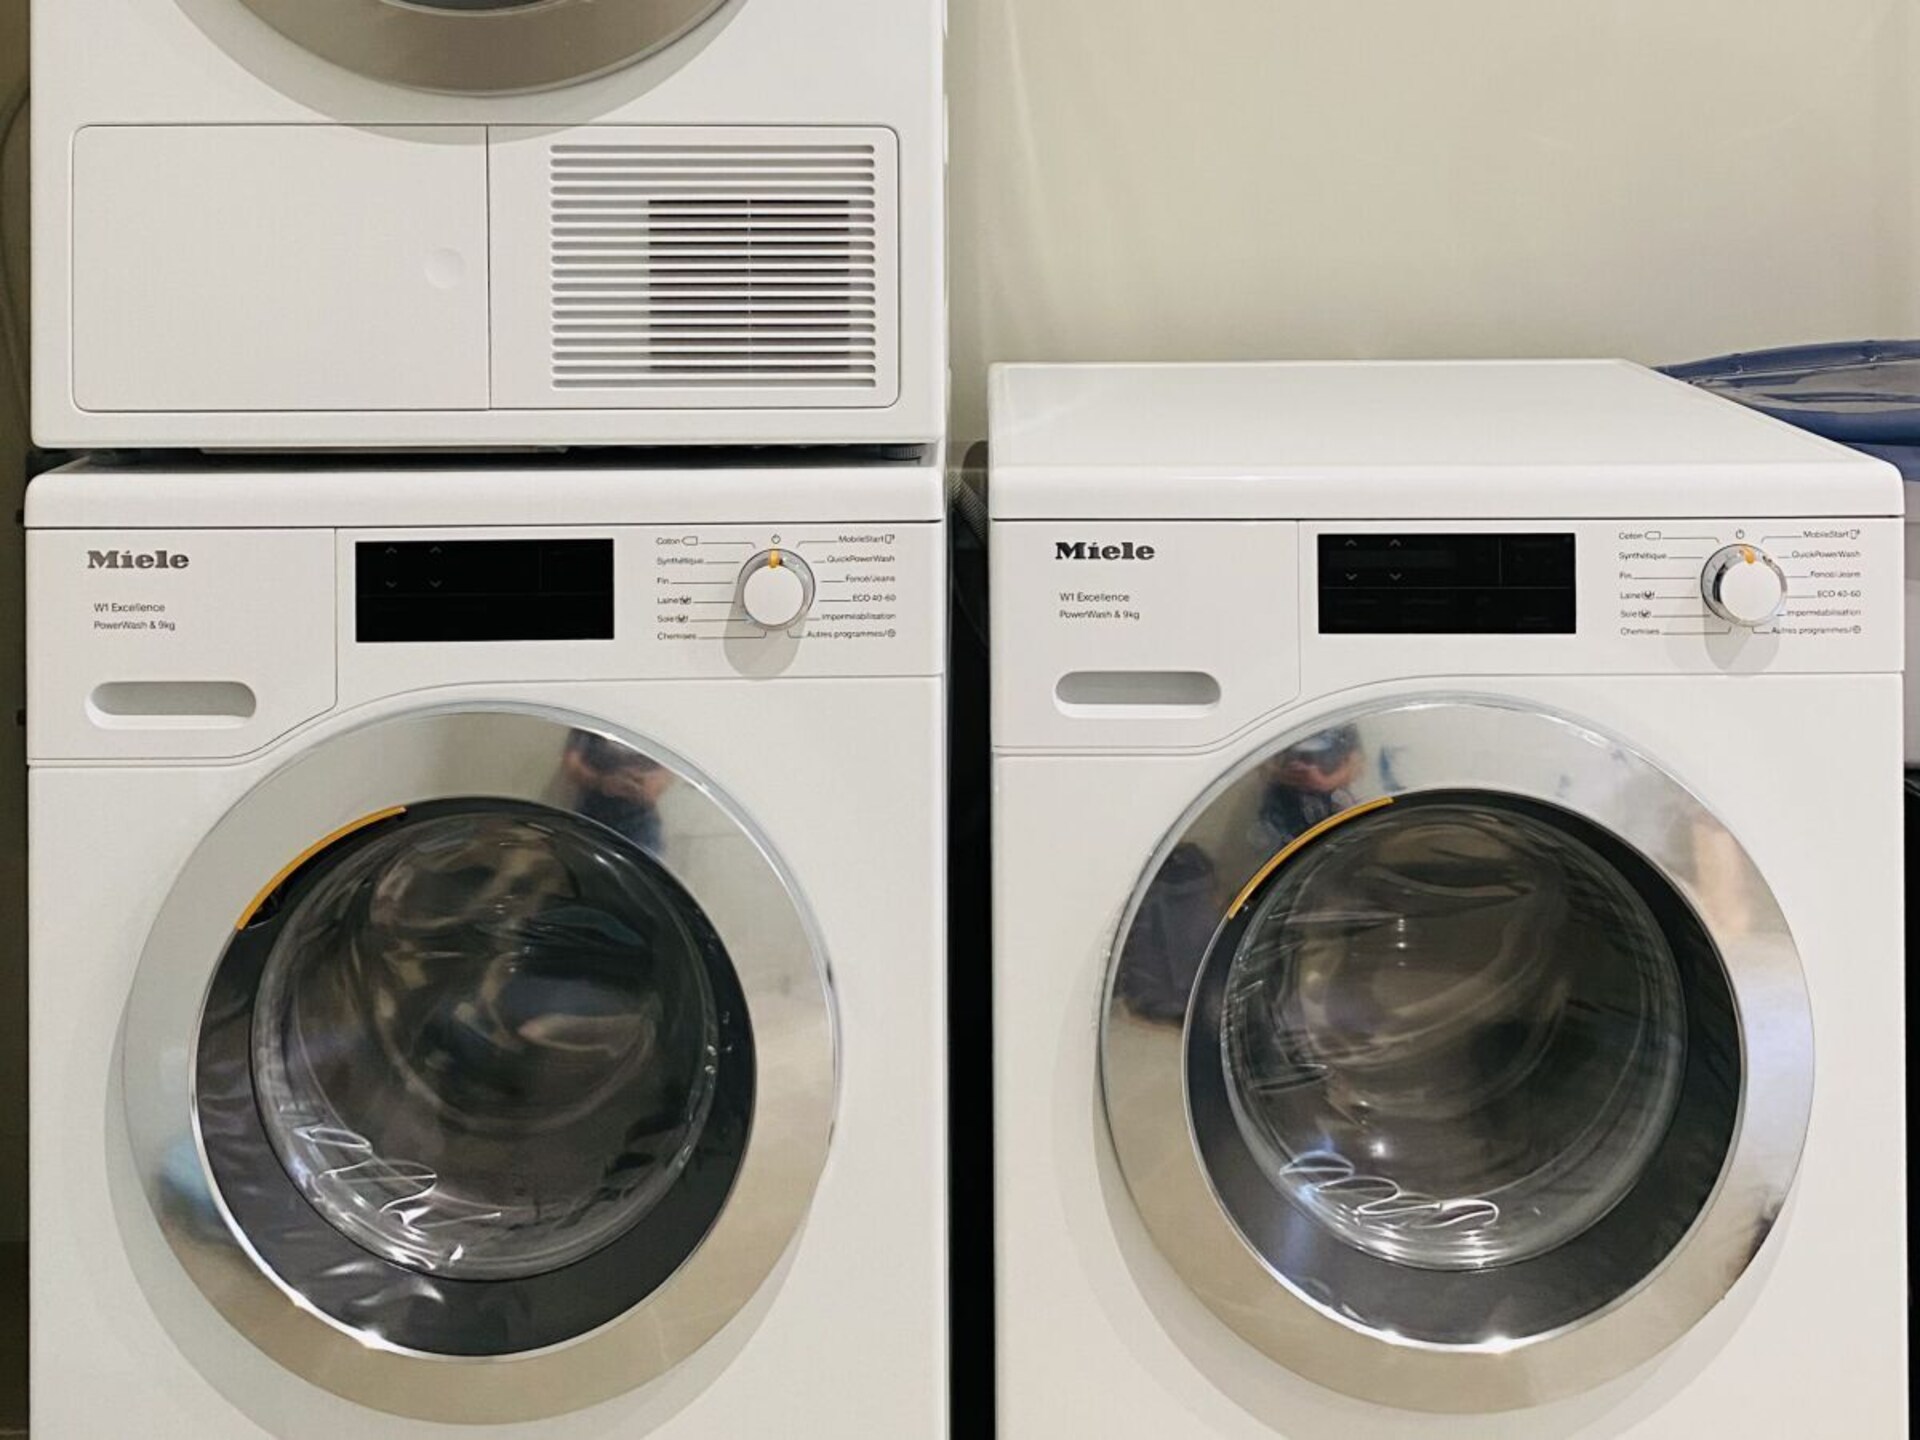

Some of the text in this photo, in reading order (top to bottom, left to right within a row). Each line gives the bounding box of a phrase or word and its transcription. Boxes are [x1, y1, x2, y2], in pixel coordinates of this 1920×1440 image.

[1619, 532, 1643, 540] Coton
[656, 537, 680, 545] Coton
[1055, 542, 1155, 560] Miele
[1792, 550, 1860, 558] QuickPowerWash
[88, 550, 189, 569] Miele
[827, 555, 895, 563] QuickPowerWash
[852, 594, 871, 602] ECO
[1059, 592, 1130, 602] W1 Excellence
[1817, 590, 1836, 598] ECO
[94, 603, 166, 613] W1 Excellence
[1059, 610, 1140, 621] PowerWash & 9kg
[94, 621, 176, 632] PowerWash & 9kg
[807, 630, 832, 638] Autres
[1620, 627, 1659, 635] Chemises
[1772, 627, 1797, 635] Autres
[656, 632, 697, 640] Chemises
